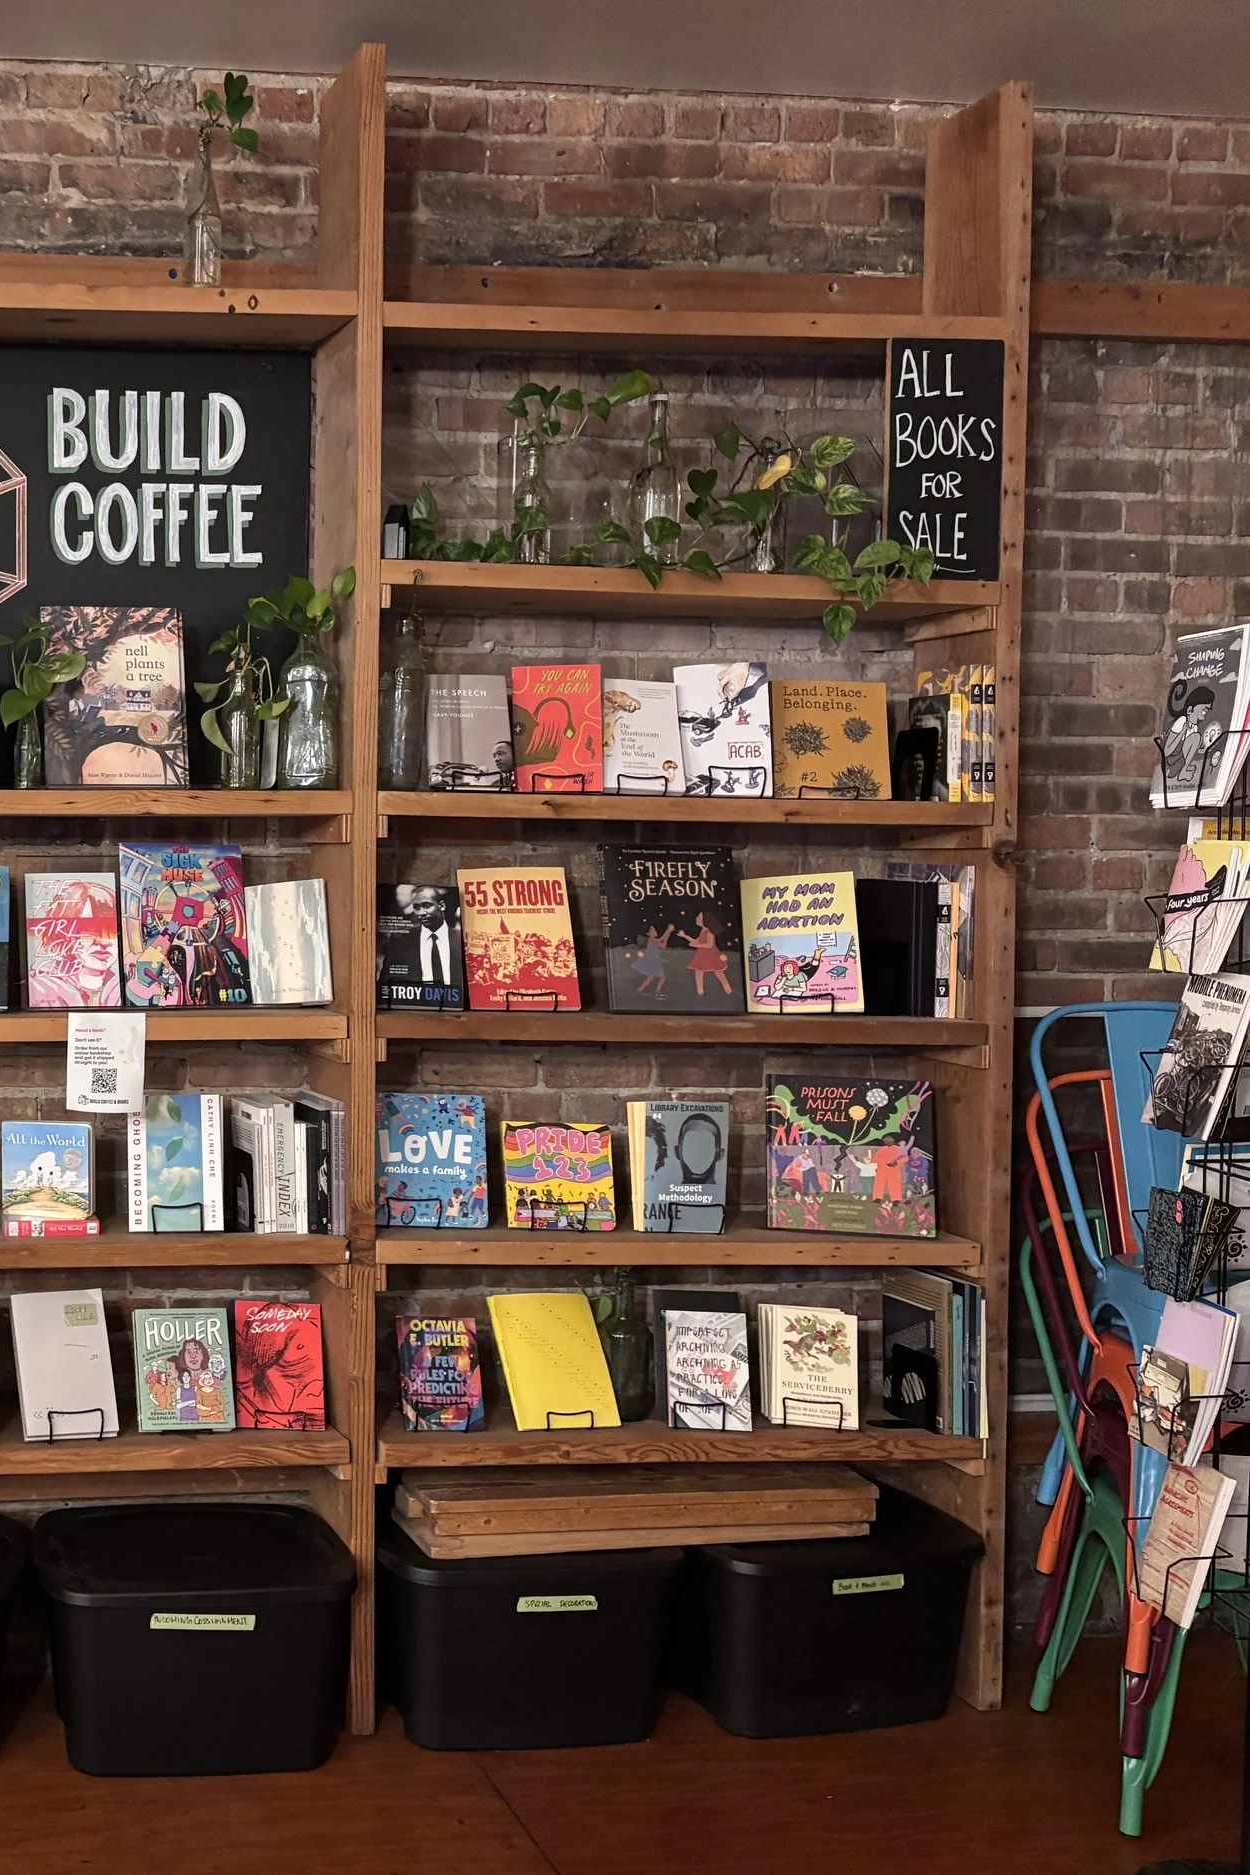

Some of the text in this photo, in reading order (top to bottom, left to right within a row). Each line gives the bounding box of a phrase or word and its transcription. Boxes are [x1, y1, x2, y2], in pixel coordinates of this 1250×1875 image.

[895, 348, 963, 398] ALL
[50, 386, 247, 473] BUILD
[895, 412, 996, 467] BOOKS
[919, 471, 963, 498] FOR
[52, 481, 263, 566] COFFEE
[899, 510, 967, 560] SALE
[125, 646, 148, 656] nell
[1188, 647, 1225, 665] SHAPING
[125, 658, 165, 671] plants
[1186, 663, 1223, 680] CHANGE
[139, 672, 163, 682] tree
[452, 689, 487, 697] SPEECH
[556, 683, 592, 694] AGAIN
[783, 686, 867, 699] Land. Place.
[783, 699, 858, 712] Belonging.
[620, 730, 660, 738] Mushroom
[730, 745, 762, 759] ACAB
[801, 772, 817, 782] #2
[161, 852, 203, 869] SICK
[161, 868, 204, 882] MUSE
[628, 860, 711, 878] FIREFLY
[32, 879, 72, 898] THE
[464, 880, 565, 908] 55 STRONG
[629, 879, 718, 902] SEASON
[762, 882, 836, 899] MY MOM
[766, 897, 834, 914] HAD AN
[1184, 892, 1209, 908] years
[30, 919, 80, 936] GIRL
[757, 913, 845, 930] ABORTION
[35, 937, 94, 957] LOVE
[30, 959, 85, 978] CLUB
[218, 988, 248, 1003] #10
[391, 985, 460, 1002] TROY DAVIS
[801, 1087, 857, 1099] PRISONS
[650, 1103, 724, 1113] LIBRARY EXCAVATIONS
[806, 1099, 849, 1110] MUST
[816, 1111, 848, 1122] FALL
[6, 1132, 86, 1147] All the World
[379, 1129, 472, 1164] LOVE
[516, 1126, 602, 1155] PRIDE
[276, 1122, 291, 1217] EMERGENCY INDEX
[384, 1165, 420, 1174] makes
[433, 1165, 467, 1180] family
[134, 1154, 142, 1225] BECOMING
[669, 1184, 702, 1193] Suspect
[658, 1193, 713, 1203] Methodology
[245, 1306, 312, 1323] SOMEDAY
[251, 1322, 291, 1334] SOON
[410, 1319, 466, 1332] OCTAVIA
[145, 1318, 223, 1350] HOLLER
[425, 1334, 469, 1347] BUTLER
[807, 1374, 828, 1383] THE
[410, 1382, 481, 1395] PREDICTING
[782, 1380, 853, 1395] SERVICEBERRY
[525, 1599, 552, 1607] SPECIAL
